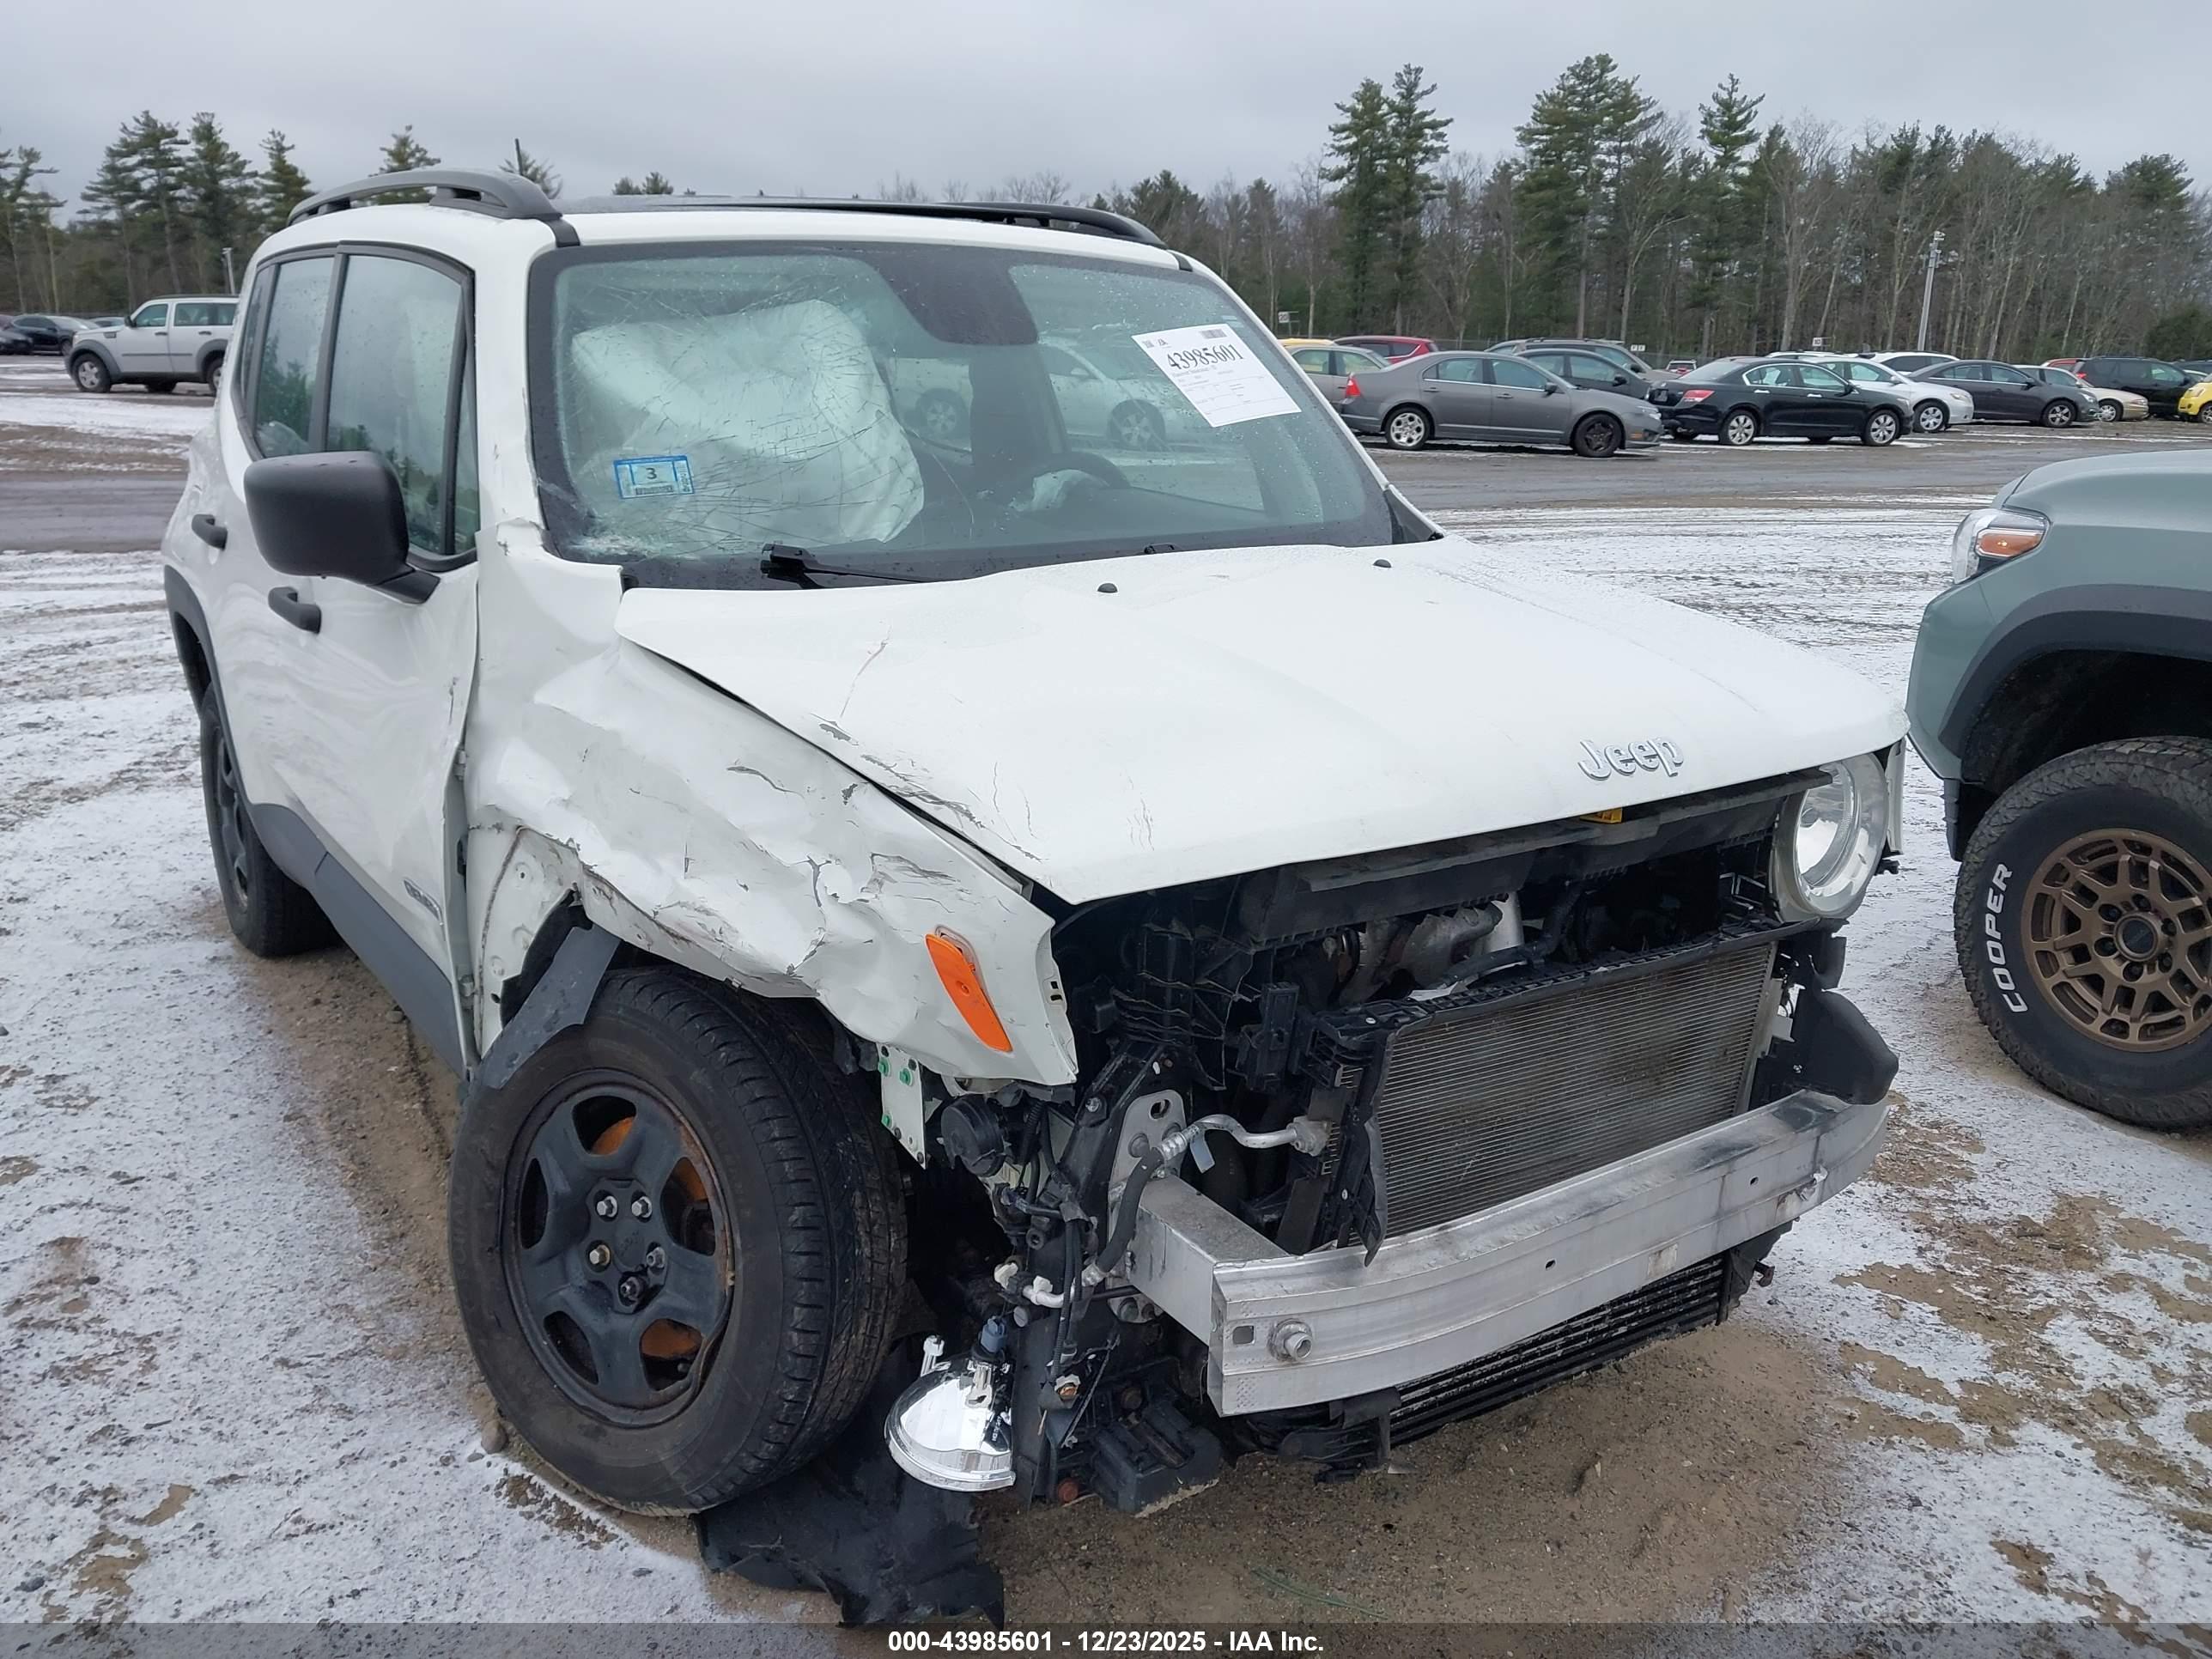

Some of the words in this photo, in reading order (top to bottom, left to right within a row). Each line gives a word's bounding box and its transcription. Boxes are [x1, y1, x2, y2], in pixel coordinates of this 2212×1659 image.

[1167, 343, 1244, 370] 43985601
[646, 467, 658, 480] 3
[1577, 737, 1685, 781] Jeep
[1985, 863, 2028, 1013] COOPER
